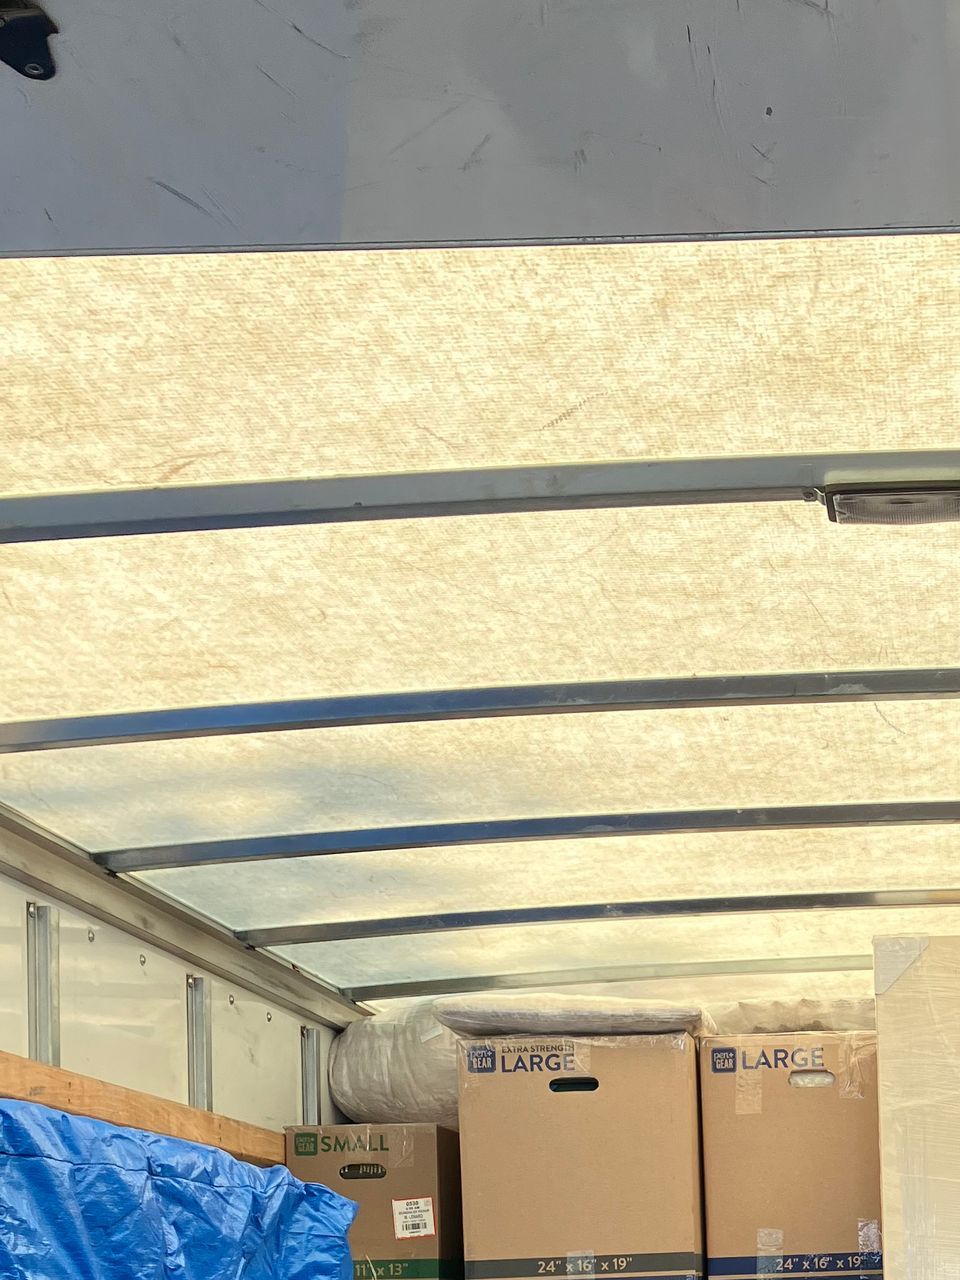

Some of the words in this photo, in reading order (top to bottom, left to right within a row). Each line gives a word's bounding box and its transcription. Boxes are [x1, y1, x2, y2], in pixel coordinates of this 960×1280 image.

[502, 1046, 528, 1054] EXTRA
[530, 1044, 575, 1053] STRENGTH
[472, 1058, 492, 1068] GEAR
[501, 1054, 575, 1072] LARGE
[713, 1052, 734, 1062] pen+
[716, 1059, 734, 1069] GEAR
[742, 1047, 825, 1069] LARGE
[321, 1135, 389, 1152] SMALL
[376, 1267, 385, 1276] x
[389, 1262, 408, 1276] 13"
[538, 1259, 562, 1273] 24"
[565, 1263, 574, 1272] x
[576, 1258, 597, 1272] 16"
[601, 1261, 609, 1271] x
[612, 1256, 633, 1270] 19"
[775, 1257, 800, 1271] 24"
[803, 1260, 811, 1270] x
[813, 1256, 832, 1269] 16"
[836, 1258, 845, 1268] x
